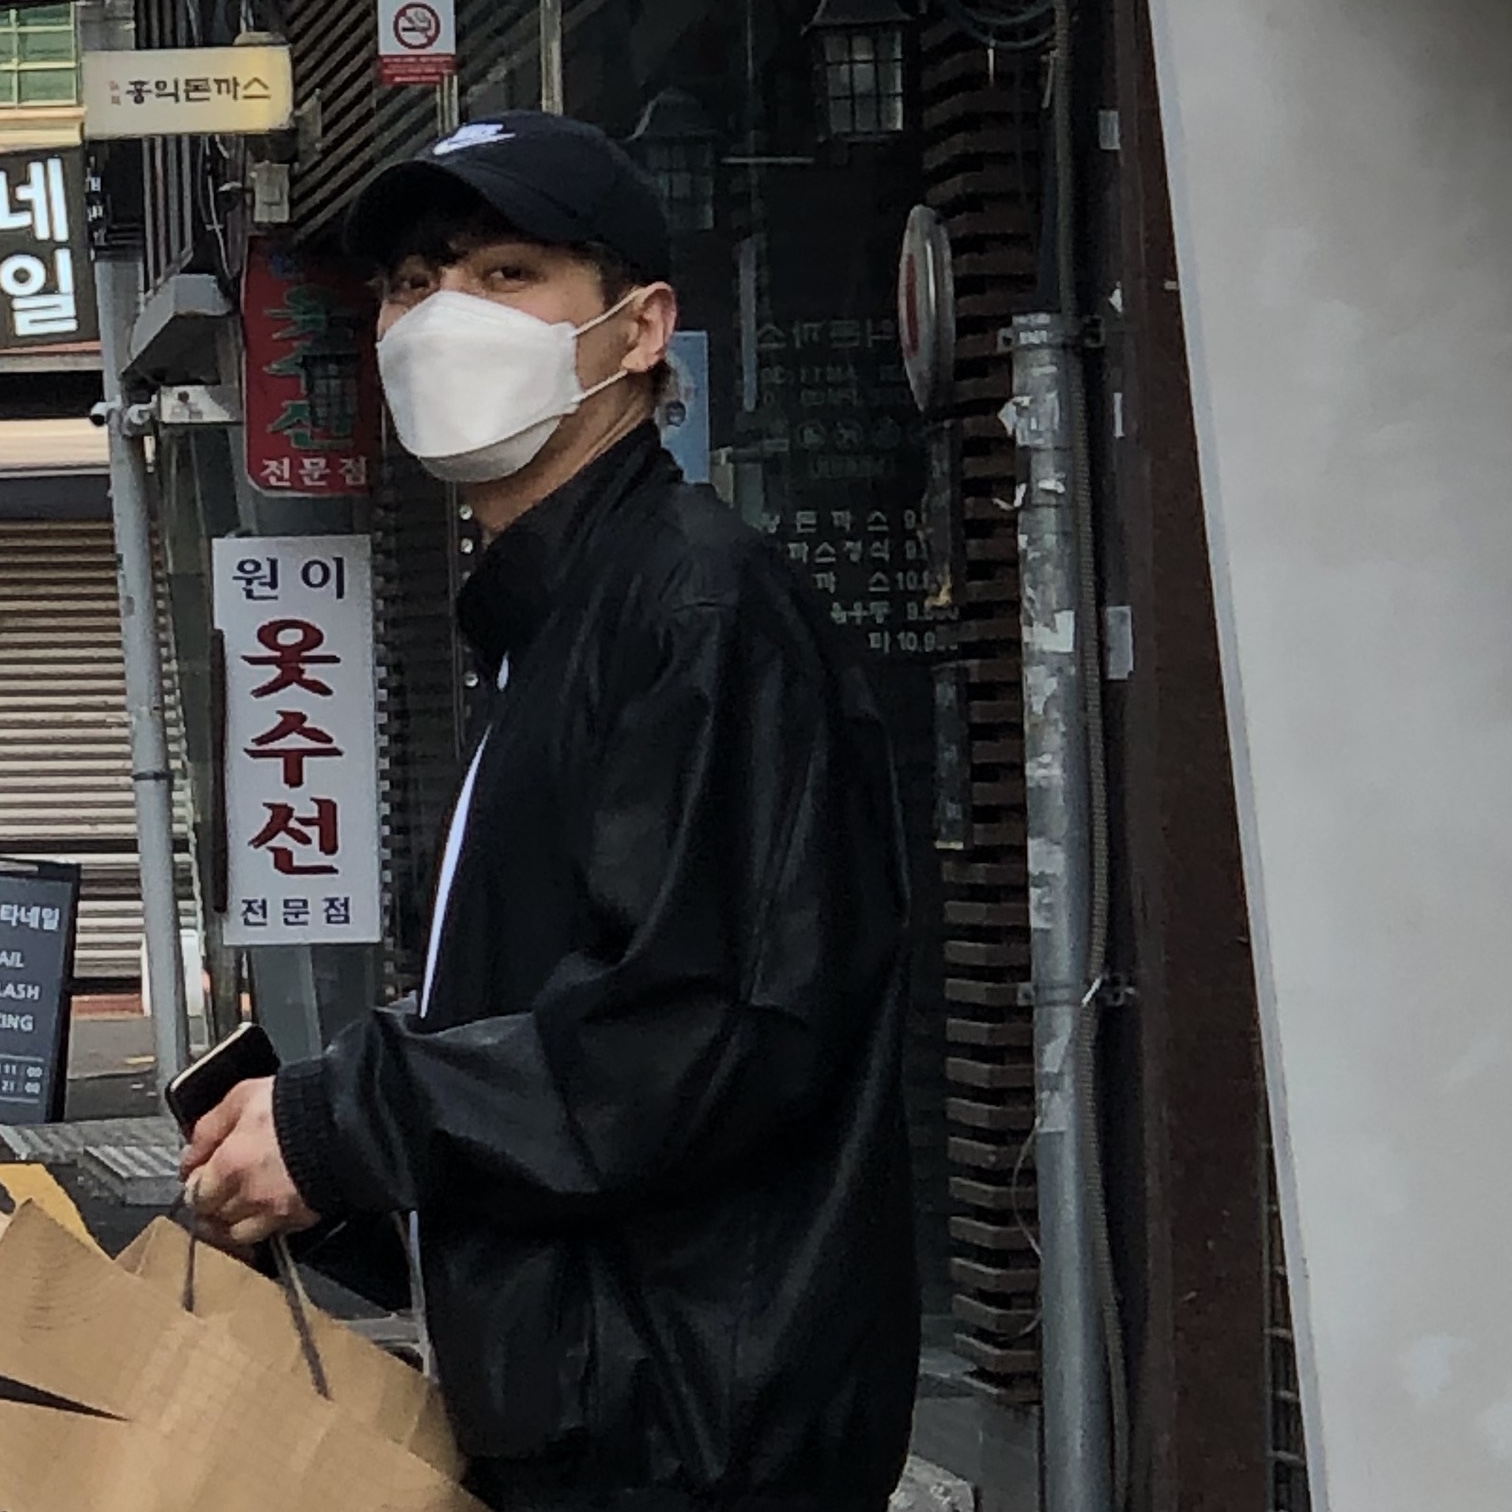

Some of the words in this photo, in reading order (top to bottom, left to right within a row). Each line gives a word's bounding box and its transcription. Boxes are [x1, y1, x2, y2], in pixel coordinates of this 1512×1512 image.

[260, 453, 369, 487] 전문점
[232, 556, 346, 601] 원이
[240, 618, 345, 876] 옷수선
[240, 895, 351, 927] 전문점
